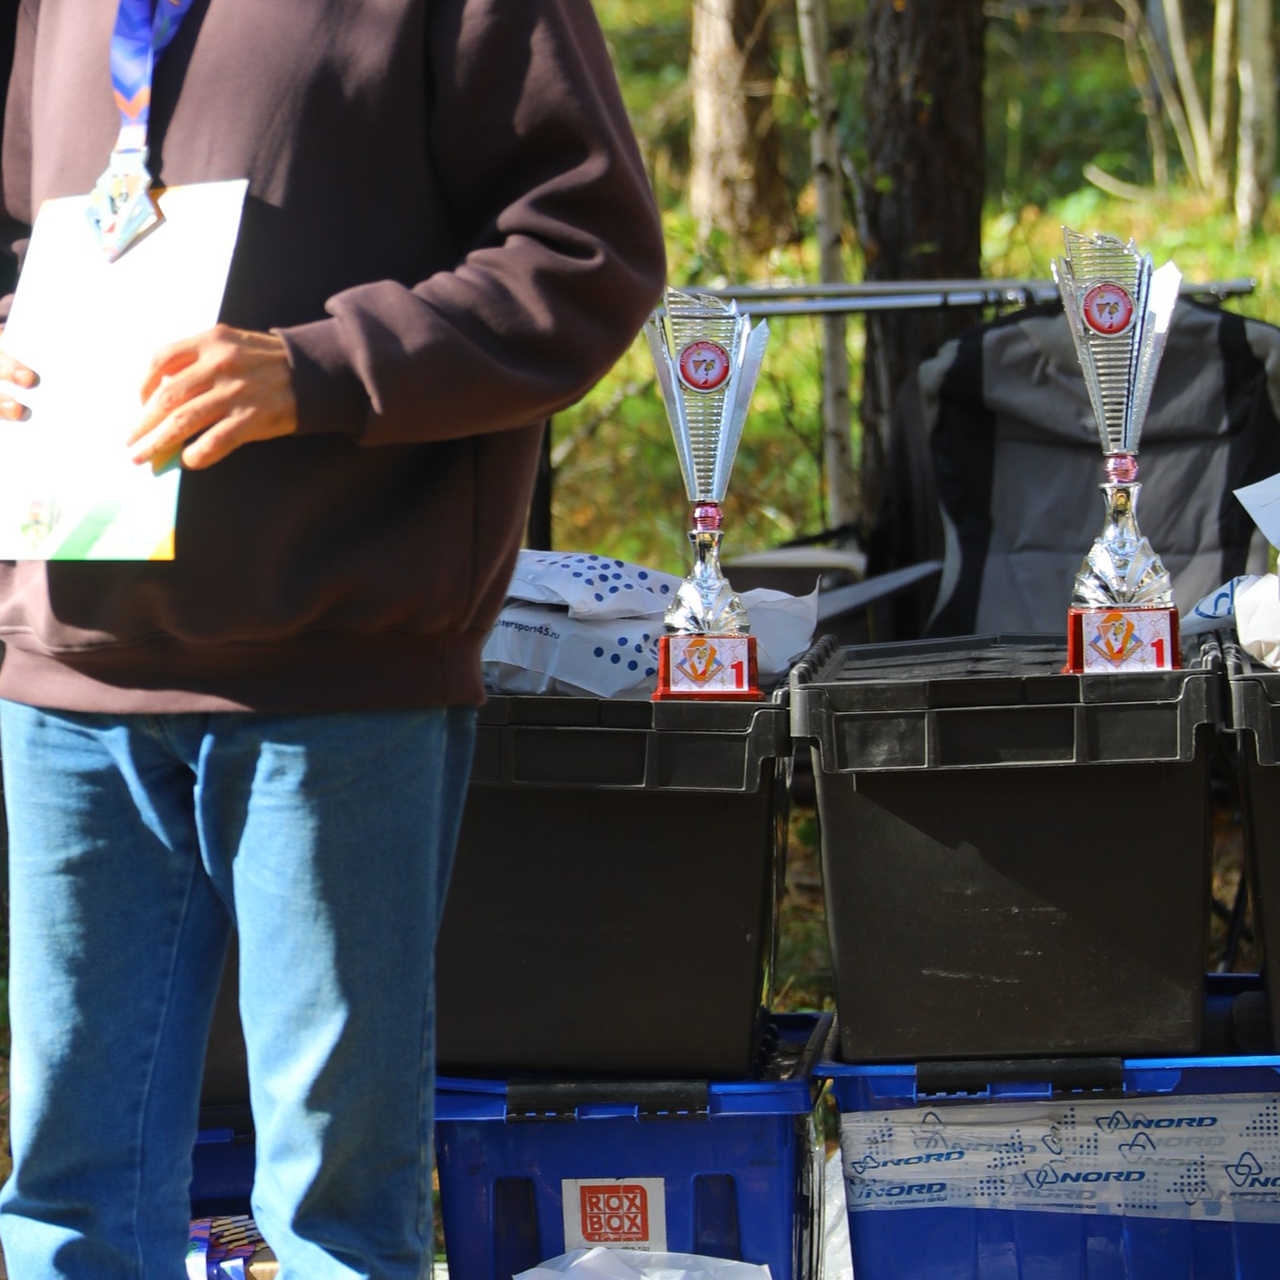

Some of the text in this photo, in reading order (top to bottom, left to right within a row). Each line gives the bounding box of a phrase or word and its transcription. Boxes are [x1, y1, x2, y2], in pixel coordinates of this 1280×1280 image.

[1150, 638, 1165, 668] 1
[730, 660, 744, 689] 1
[1131, 1116, 1218, 1129] NORD
[878, 1150, 965, 1168] NORD
[1060, 1171, 1145, 1183] NORD
[862, 1182, 947, 1198] NORD
[587, 1194, 641, 1212] ROX
[588, 1214, 641, 1232] BOX
